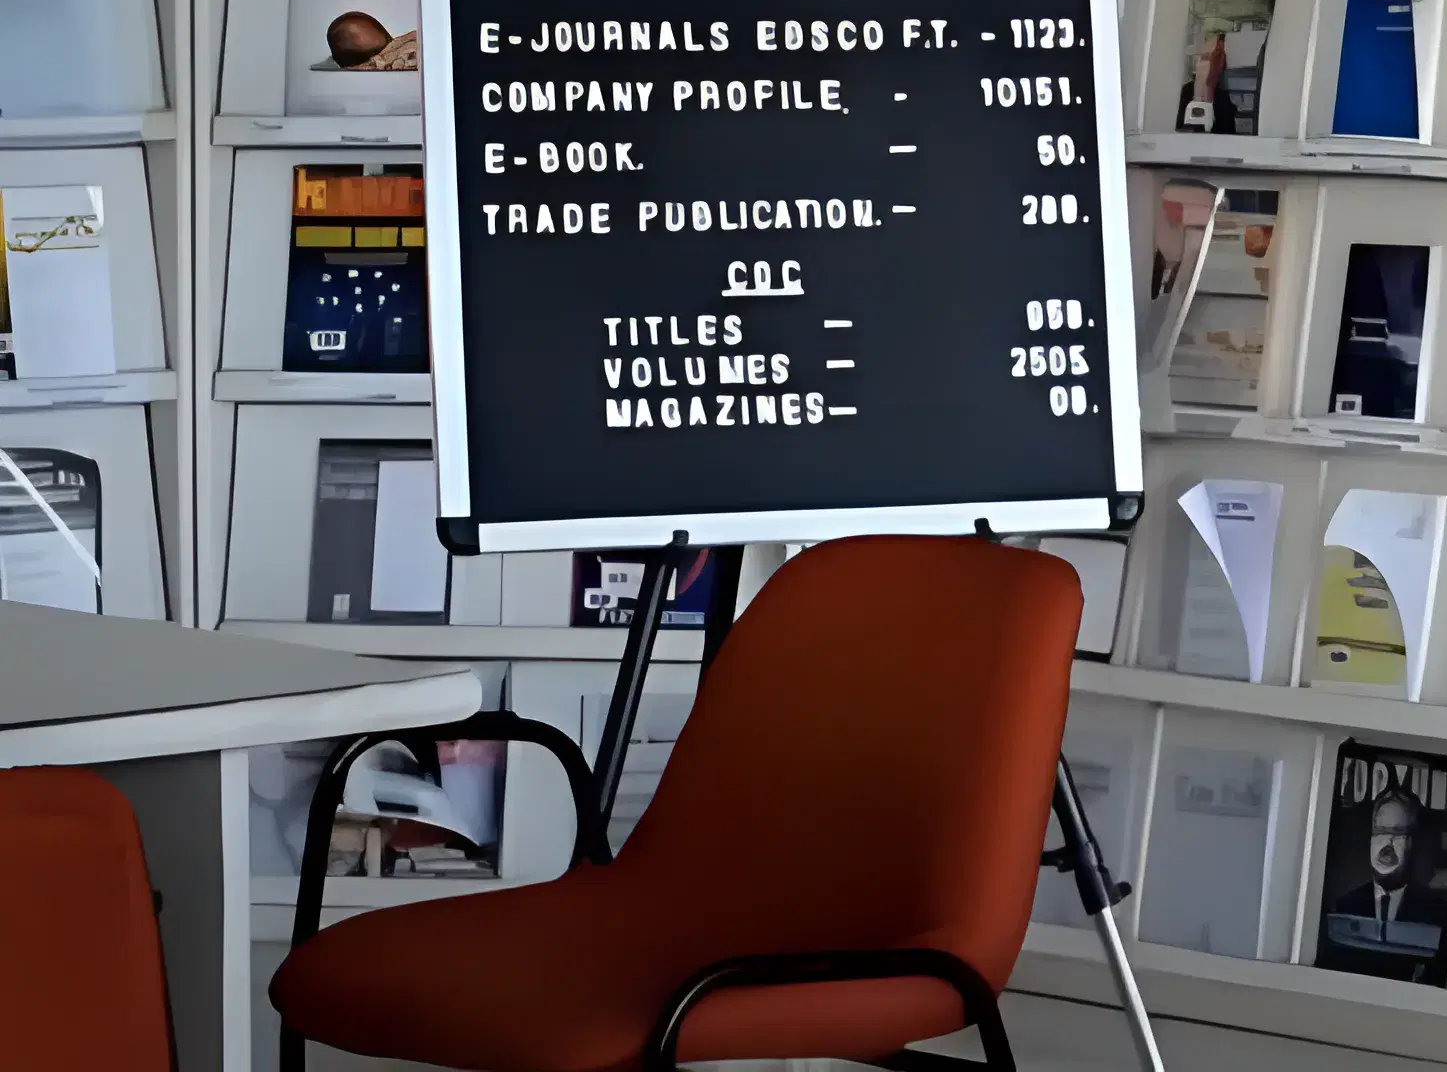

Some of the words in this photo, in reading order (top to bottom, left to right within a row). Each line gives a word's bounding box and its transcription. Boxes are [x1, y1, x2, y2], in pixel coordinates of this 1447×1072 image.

[482, 81, 654, 112] COMPANY
[483, 203, 611, 235] TRADE
[604, 314, 743, 347] TITLES
